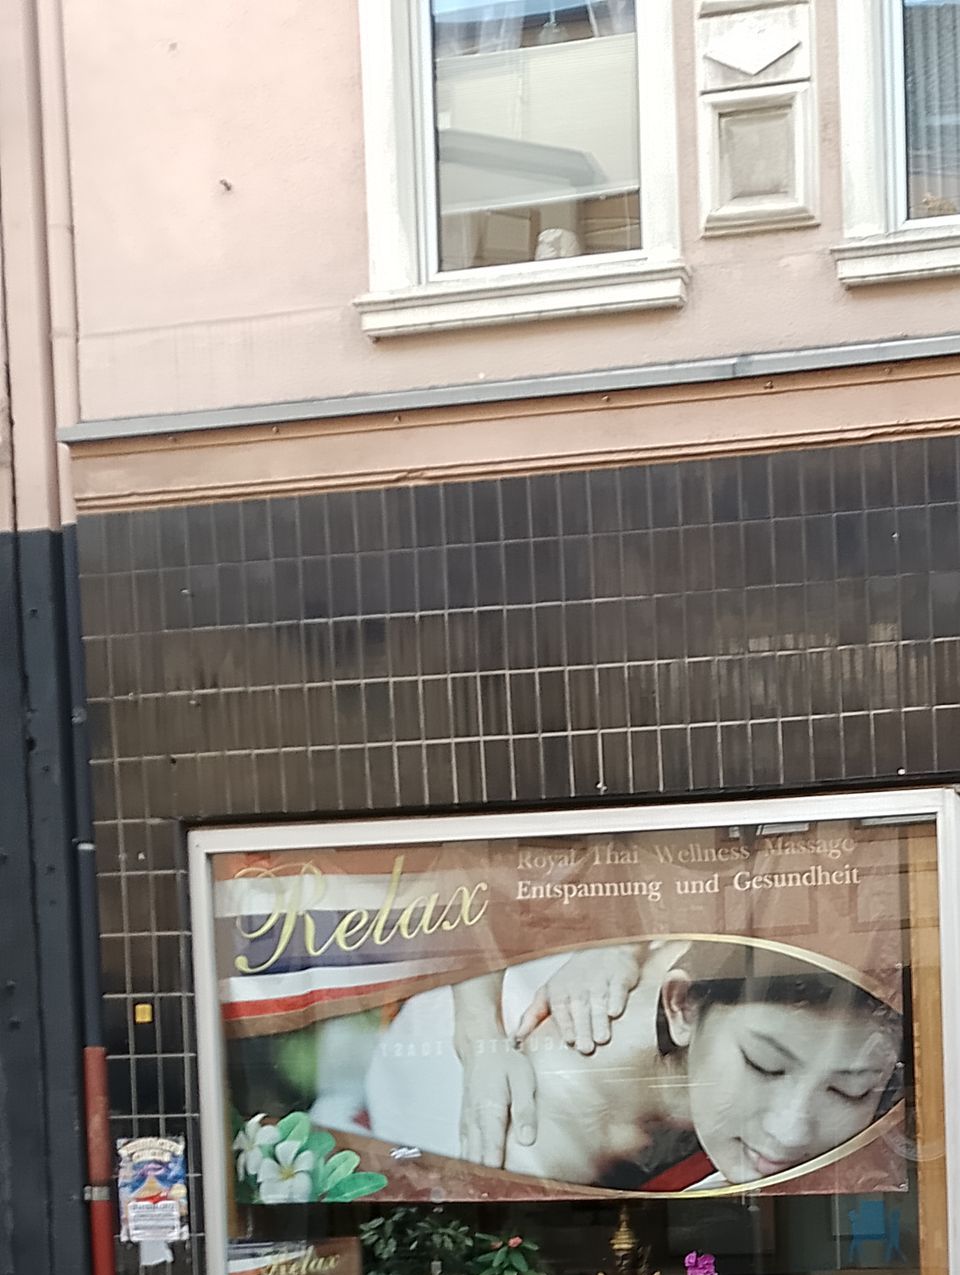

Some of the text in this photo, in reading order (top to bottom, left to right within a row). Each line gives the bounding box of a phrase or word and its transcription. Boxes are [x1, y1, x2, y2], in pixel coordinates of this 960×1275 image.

[516, 836, 856, 875] Royal Thai Wellness Massage
[516, 864, 861, 904] Entspannung und Gesundheit
[234, 855, 489, 974] Relax
